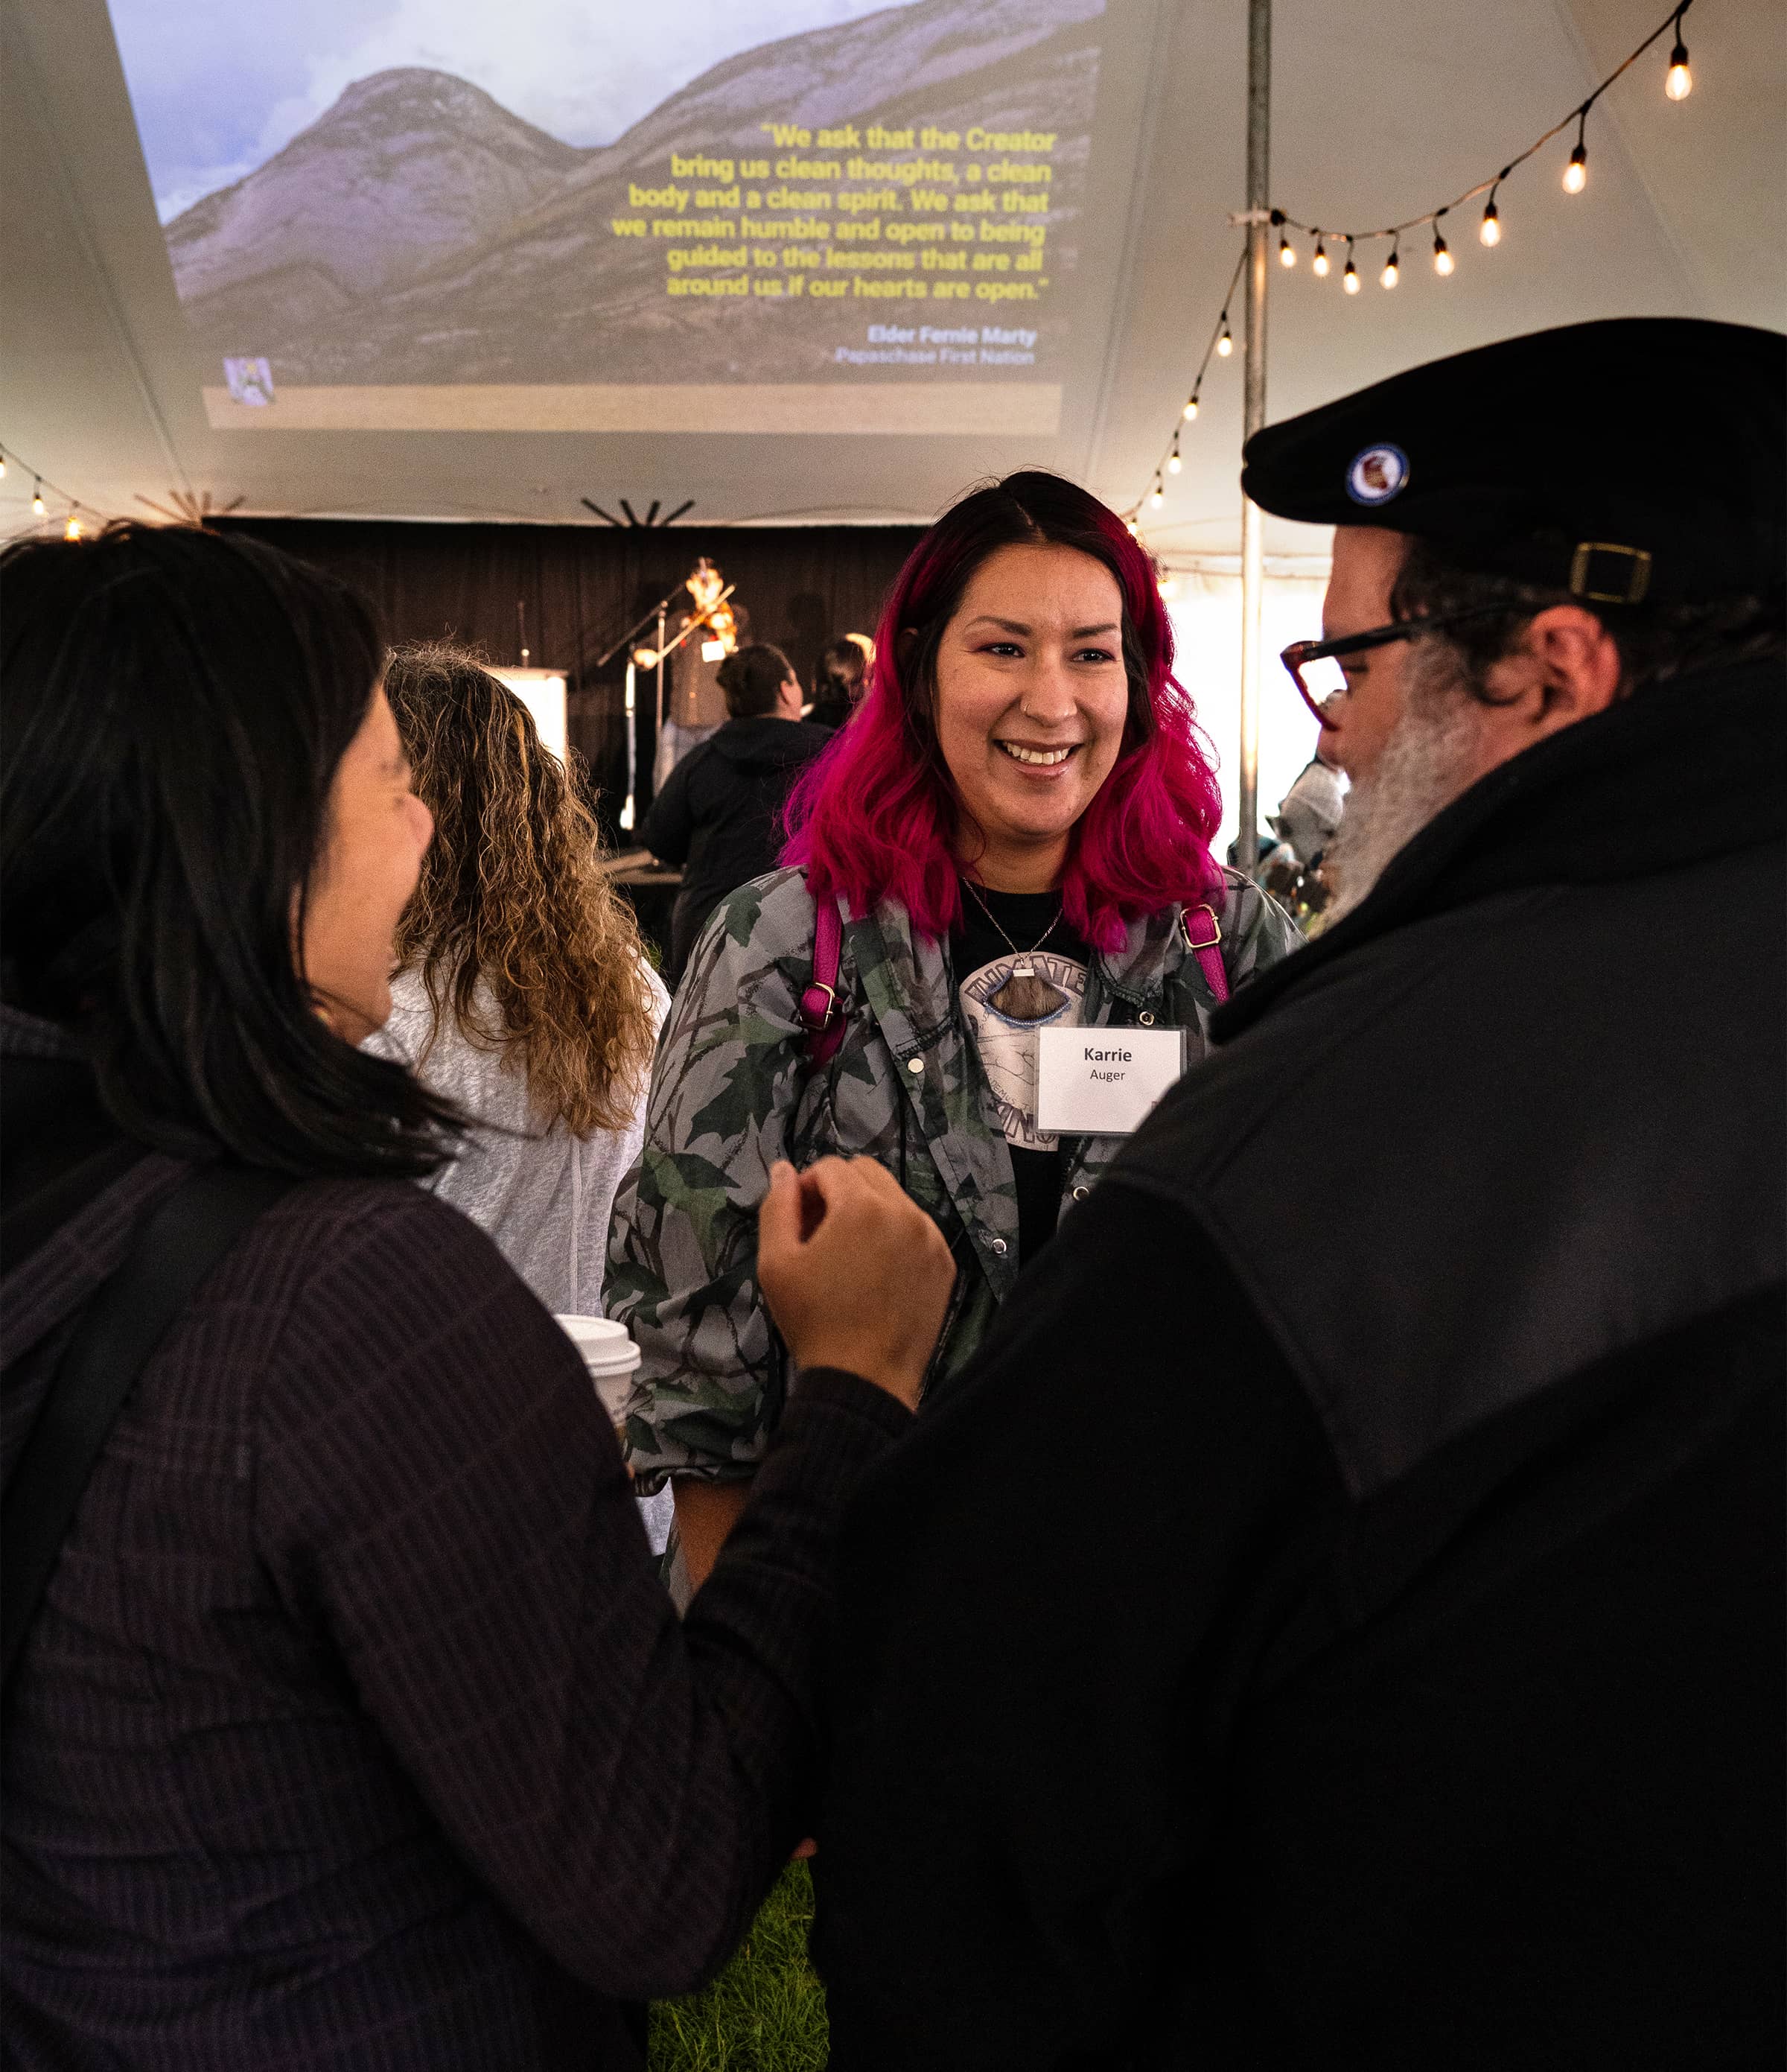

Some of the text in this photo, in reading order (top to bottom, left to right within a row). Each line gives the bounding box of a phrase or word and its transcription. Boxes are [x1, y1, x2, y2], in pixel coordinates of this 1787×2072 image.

[818, 124, 861, 148] ask
[867, 126, 914, 148] that
[920, 125, 961, 150] the
[966, 127, 1057, 151] Creator
[672, 154, 1051, 186] bring us clean thoughts, a clean
[628, 183, 1048, 214] body and a clean spirit. We ask that
[611, 215, 1045, 247] we remain humble and open to being
[668, 244, 1042, 271] guided to the lessons that are all
[667, 274, 748, 295] around
[753, 279, 782, 296] us
[788, 274, 804, 296] if
[809, 279, 848, 297] our
[854, 276, 927, 298] hearts
[933, 282, 971, 298] are
[867, 324, 1037, 349] Elder Fernie Marty
[940, 348, 976, 363] First
[979, 348, 1035, 364] Nation
[1084, 1048, 1132, 1062] Karrie
[1089, 1070, 1125, 1082] Auger
